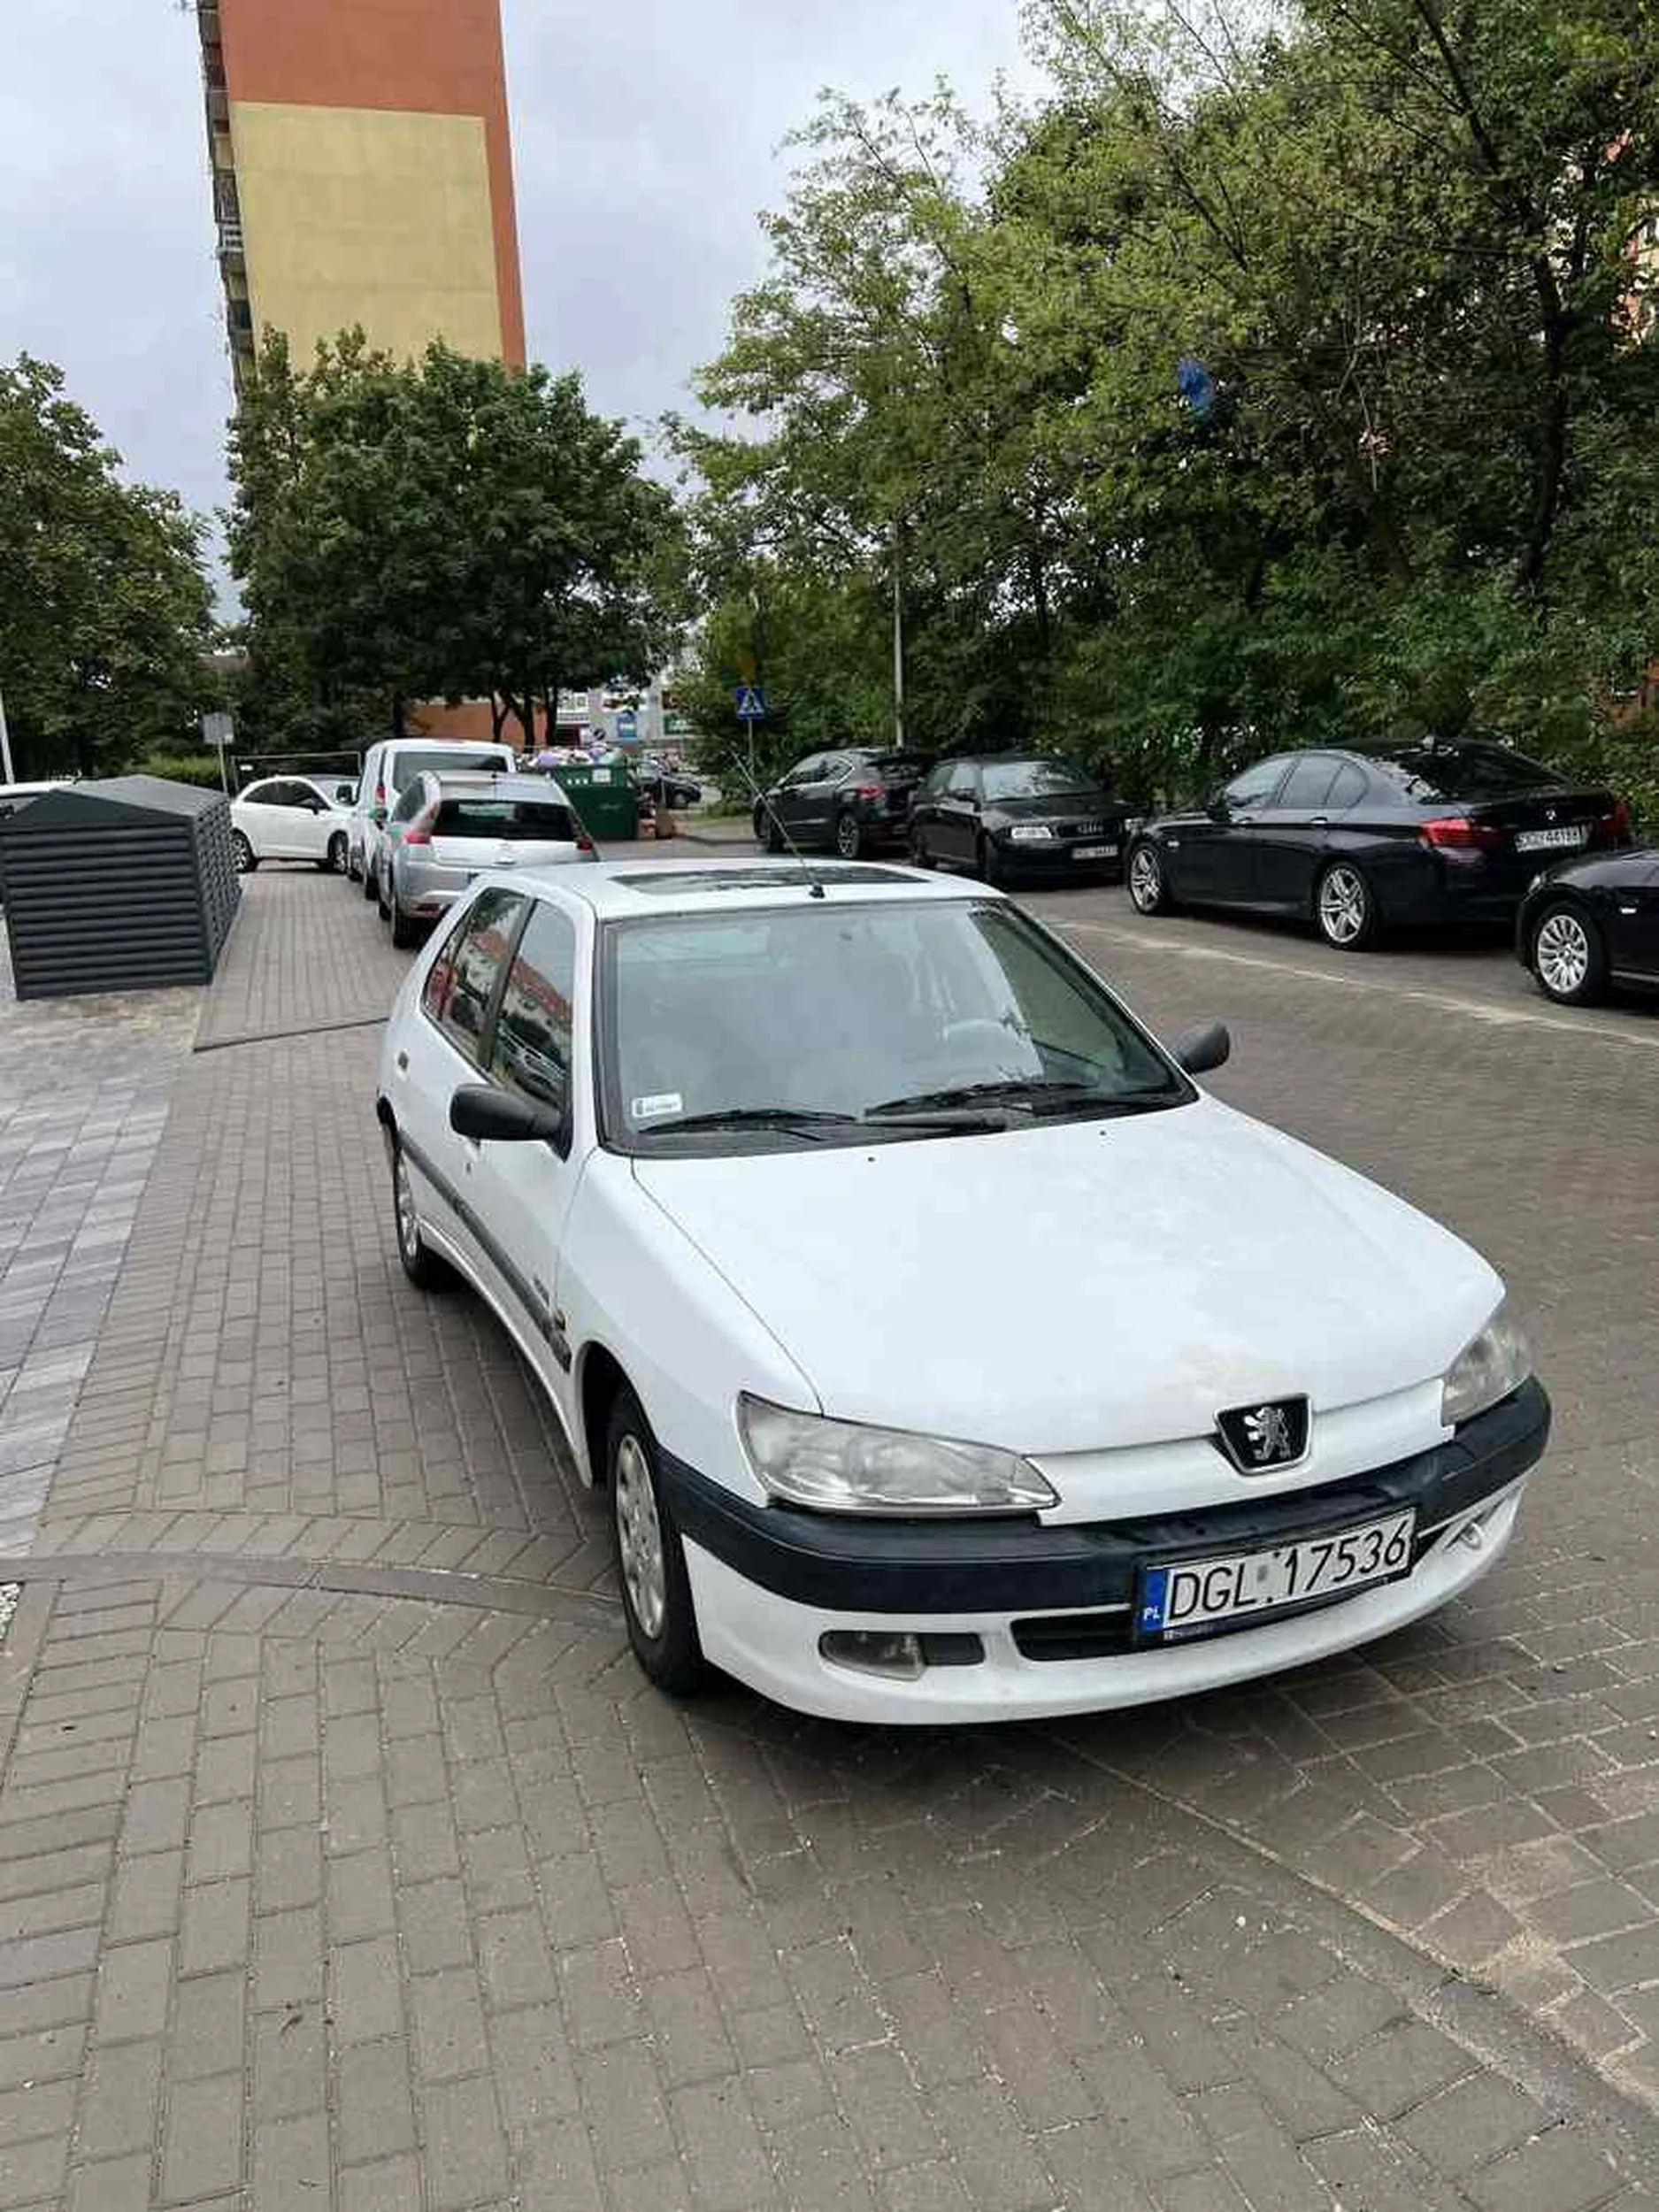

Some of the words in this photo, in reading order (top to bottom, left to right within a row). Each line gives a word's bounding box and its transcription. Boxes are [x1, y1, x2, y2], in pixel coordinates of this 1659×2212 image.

[1168, 1562, 1256, 1620] DGL
[1285, 1519, 1409, 1595] 17536
[1143, 1606, 1161, 1621] PL
